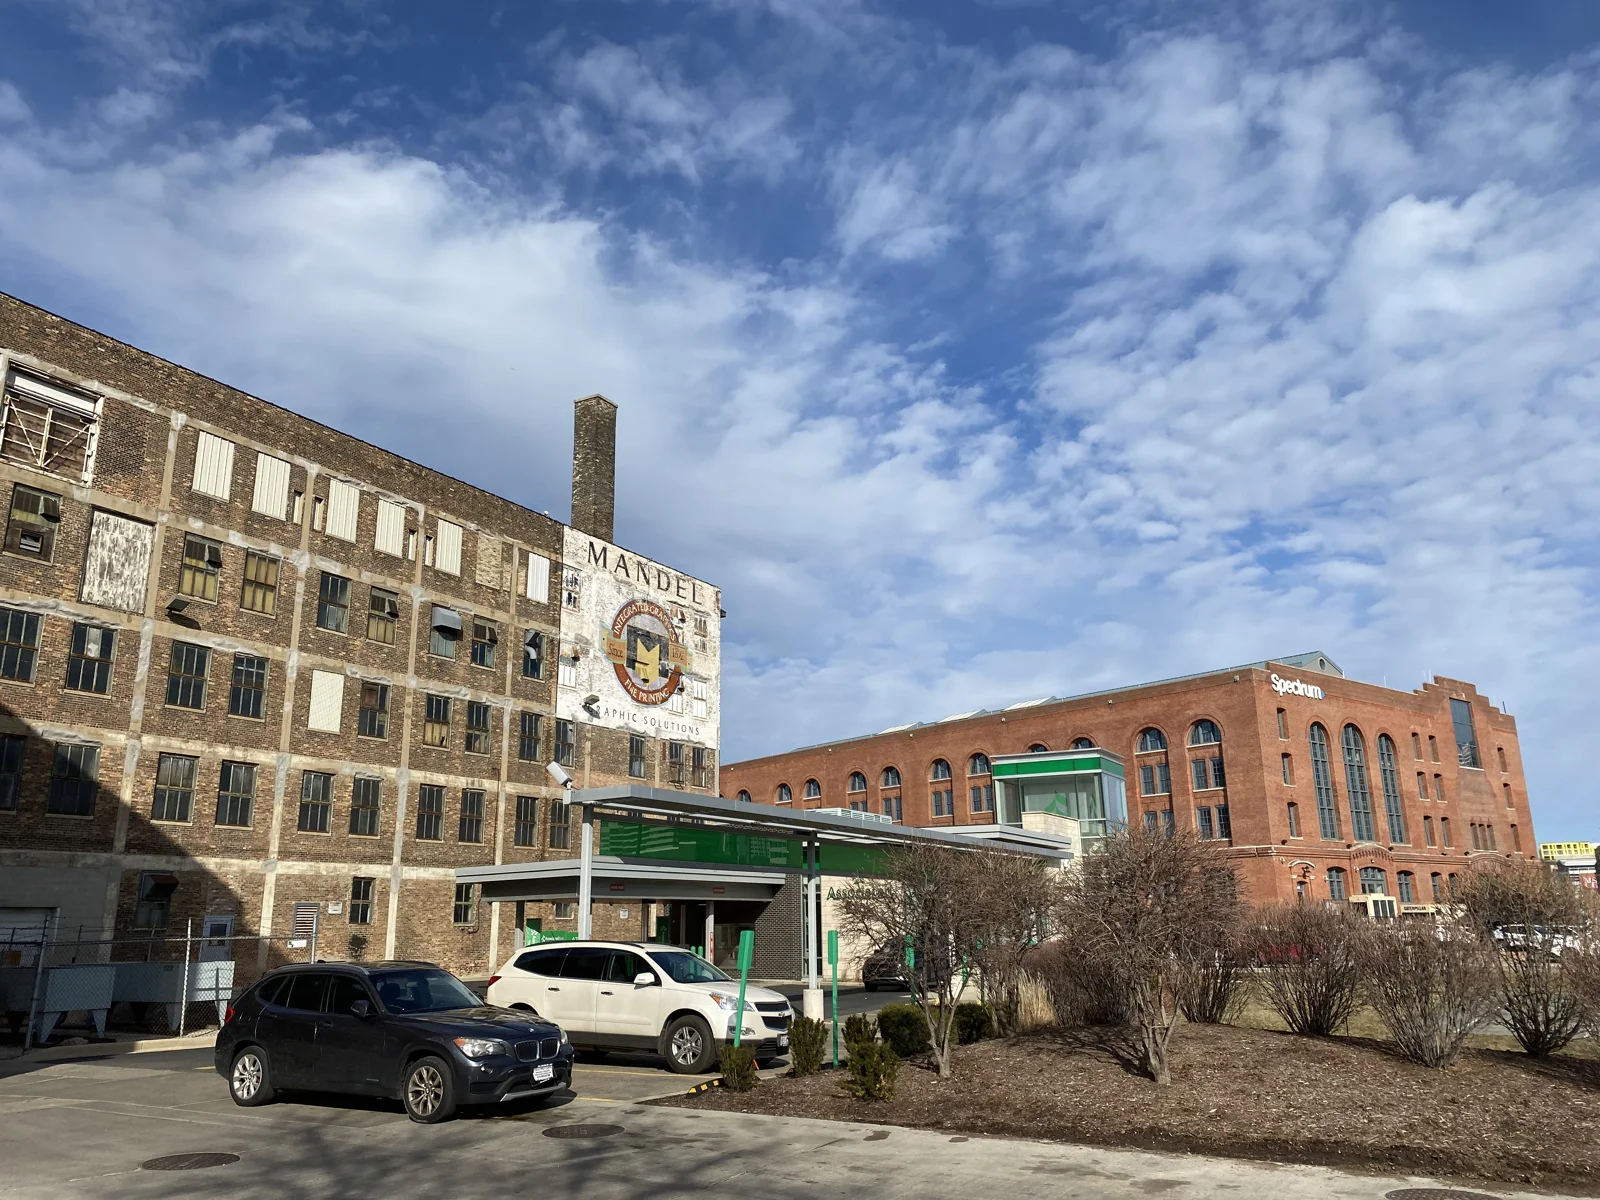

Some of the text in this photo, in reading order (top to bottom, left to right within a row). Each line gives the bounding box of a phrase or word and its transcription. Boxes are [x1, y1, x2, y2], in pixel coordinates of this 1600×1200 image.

[588, 541, 702, 605] MANDEL
[613, 602, 649, 635] INTEGRATED
[608, 642, 624, 659] Since
[624, 678, 670, 704] FINE PRINTING
[1270, 673, 1323, 700] Spectrum
[596, 705, 700, 736] RAPHIC SOLUTIONS
